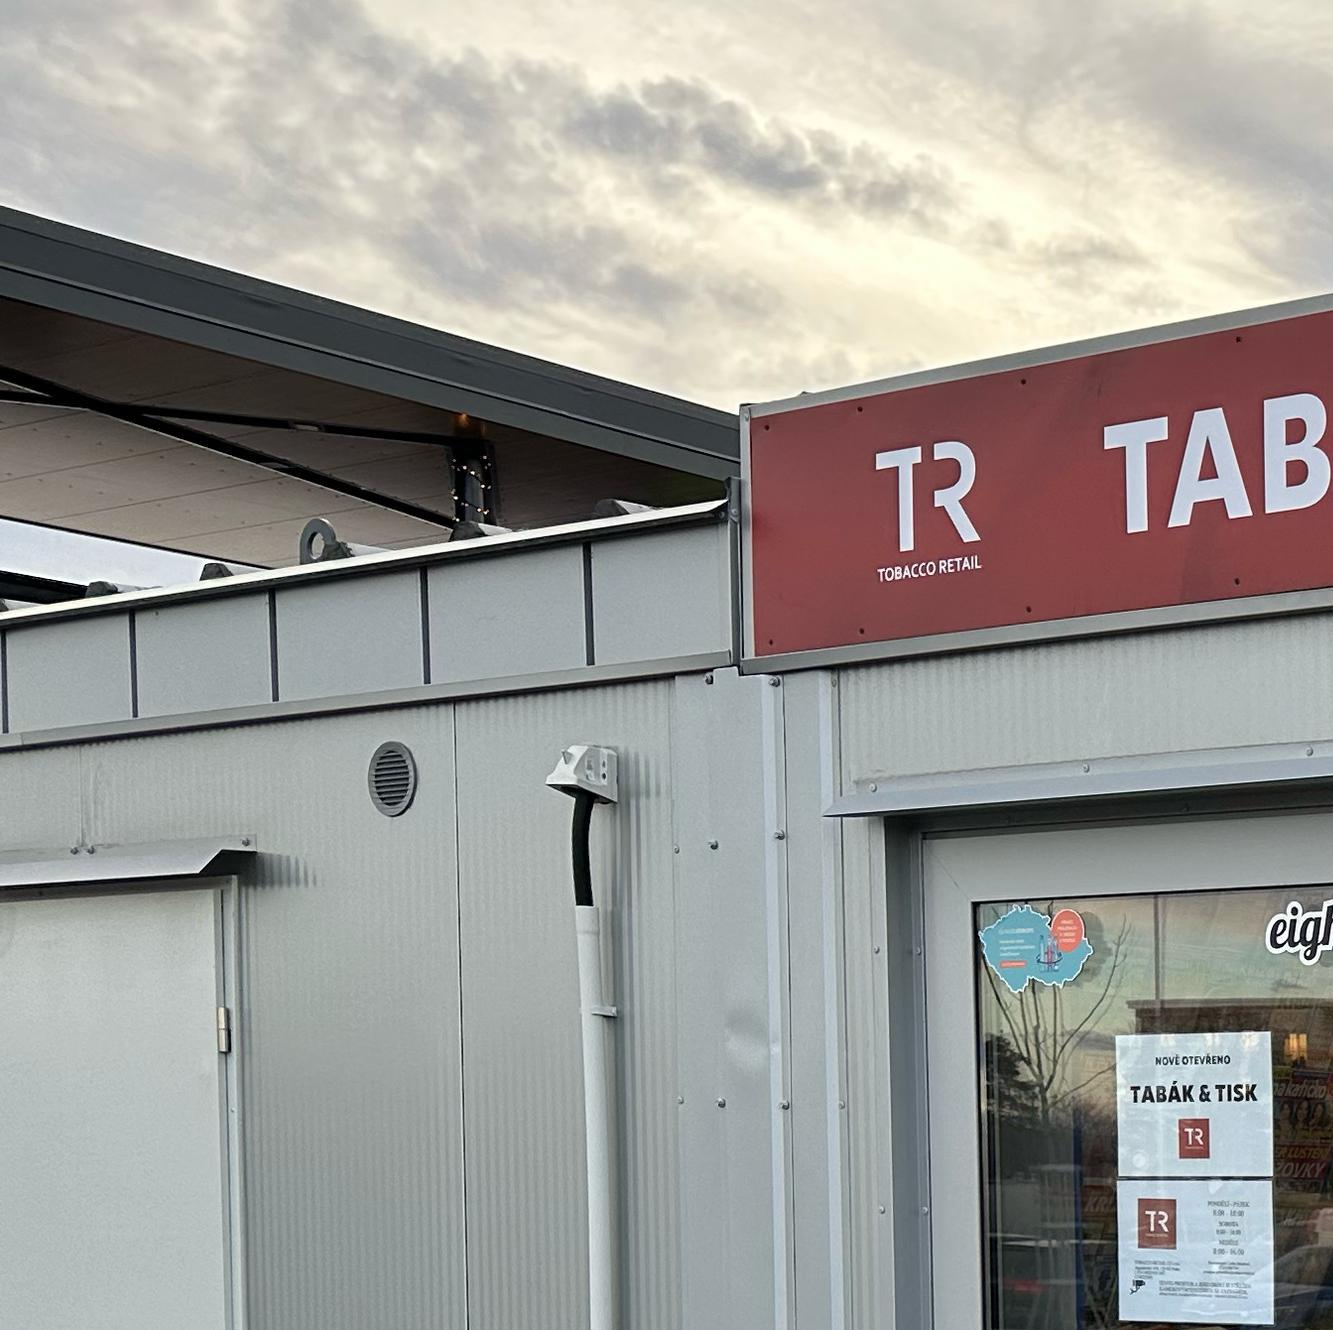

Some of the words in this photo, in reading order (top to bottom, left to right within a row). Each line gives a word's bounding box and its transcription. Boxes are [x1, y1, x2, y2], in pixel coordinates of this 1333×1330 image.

[875, 440, 981, 552] TR
[877, 560, 937, 582] TOBACCO
[938, 554, 982, 575] RETAIL
[1181, 1052, 1231, 1066] OTEVŘENO
[1130, 1081, 1195, 1104] TABÁK
[1198, 1084, 1212, 1103] &
[1215, 1083, 1259, 1102] TISK
[1184, 1127, 1205, 1146] TR
[1145, 1210, 1169, 1232] TR
